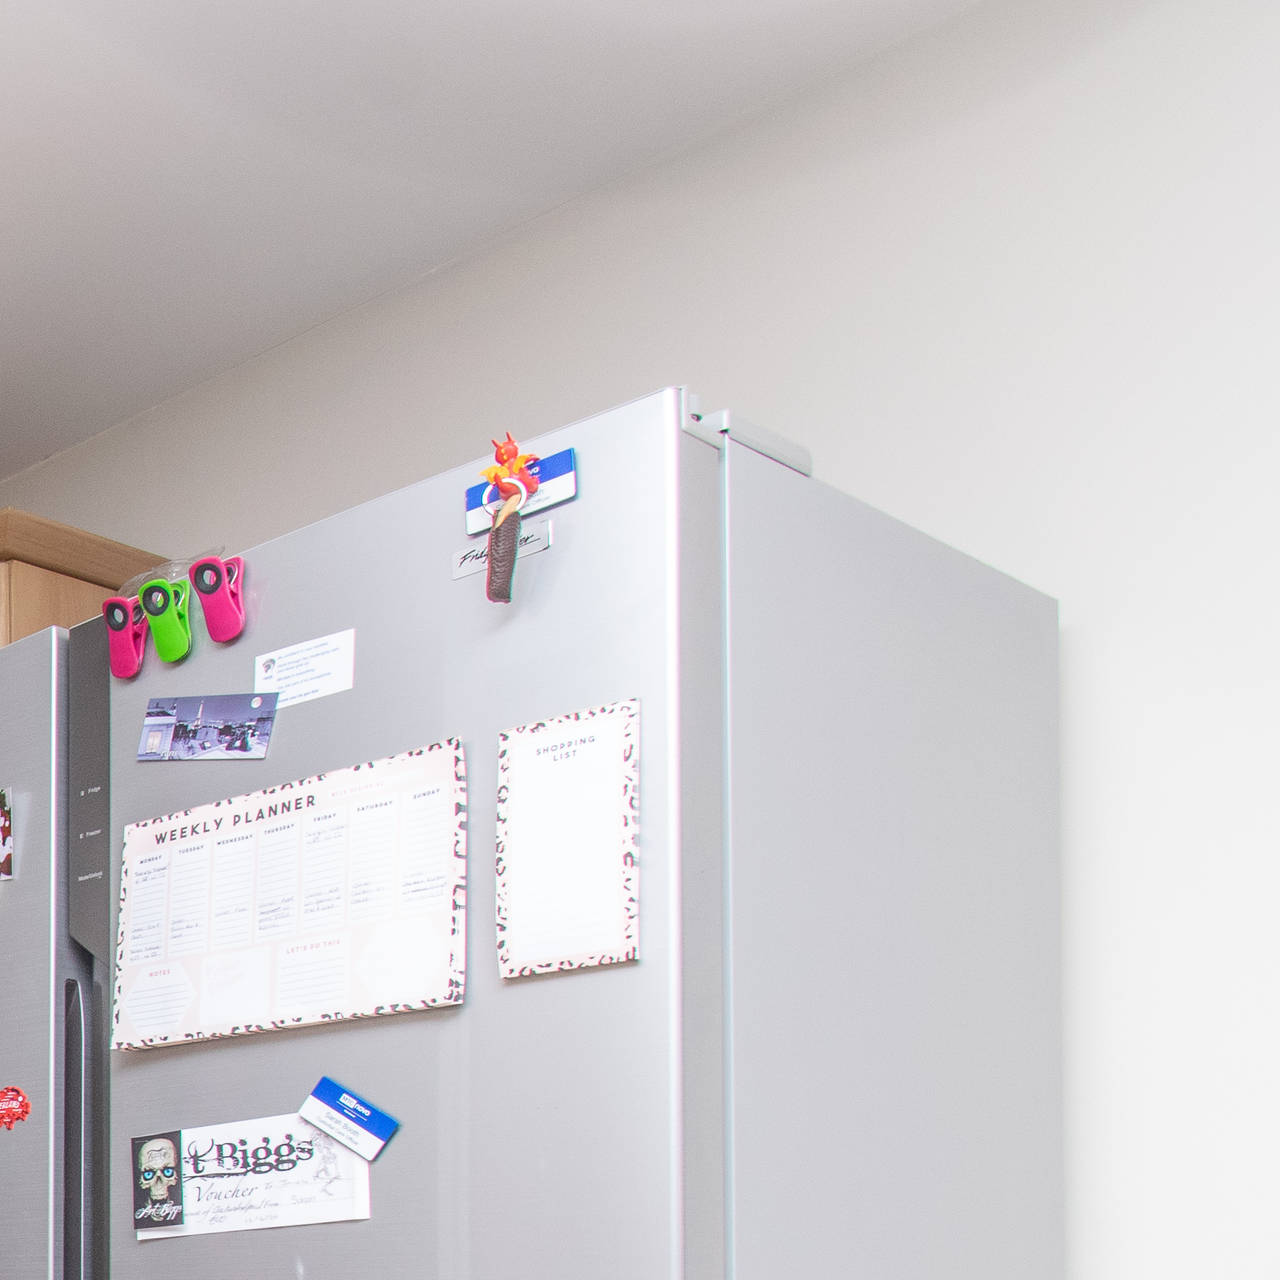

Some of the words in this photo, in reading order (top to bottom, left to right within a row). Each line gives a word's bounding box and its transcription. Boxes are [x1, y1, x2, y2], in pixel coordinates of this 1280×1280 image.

[536, 736, 595, 756] SHOPPING
[553, 749, 577, 762] LIST
[412, 788, 441, 799] SUNDAY
[357, 801, 393, 812] SATURDAY
[155, 818, 223, 845] WEEKLY
[232, 795, 316, 826] PLANNER
[313, 813, 337, 823] FRIDAY
[264, 824, 295, 835] THURSDAY
[216, 834, 254, 845] WEDNESDAY
[178, 845, 204, 855] TUESDAY
[139, 854, 162, 864] MONDAY
[149, 969, 171, 977] NOTES
[216, 1133, 314, 1175] Biggs
[195, 1185, 258, 1202] Voucher
